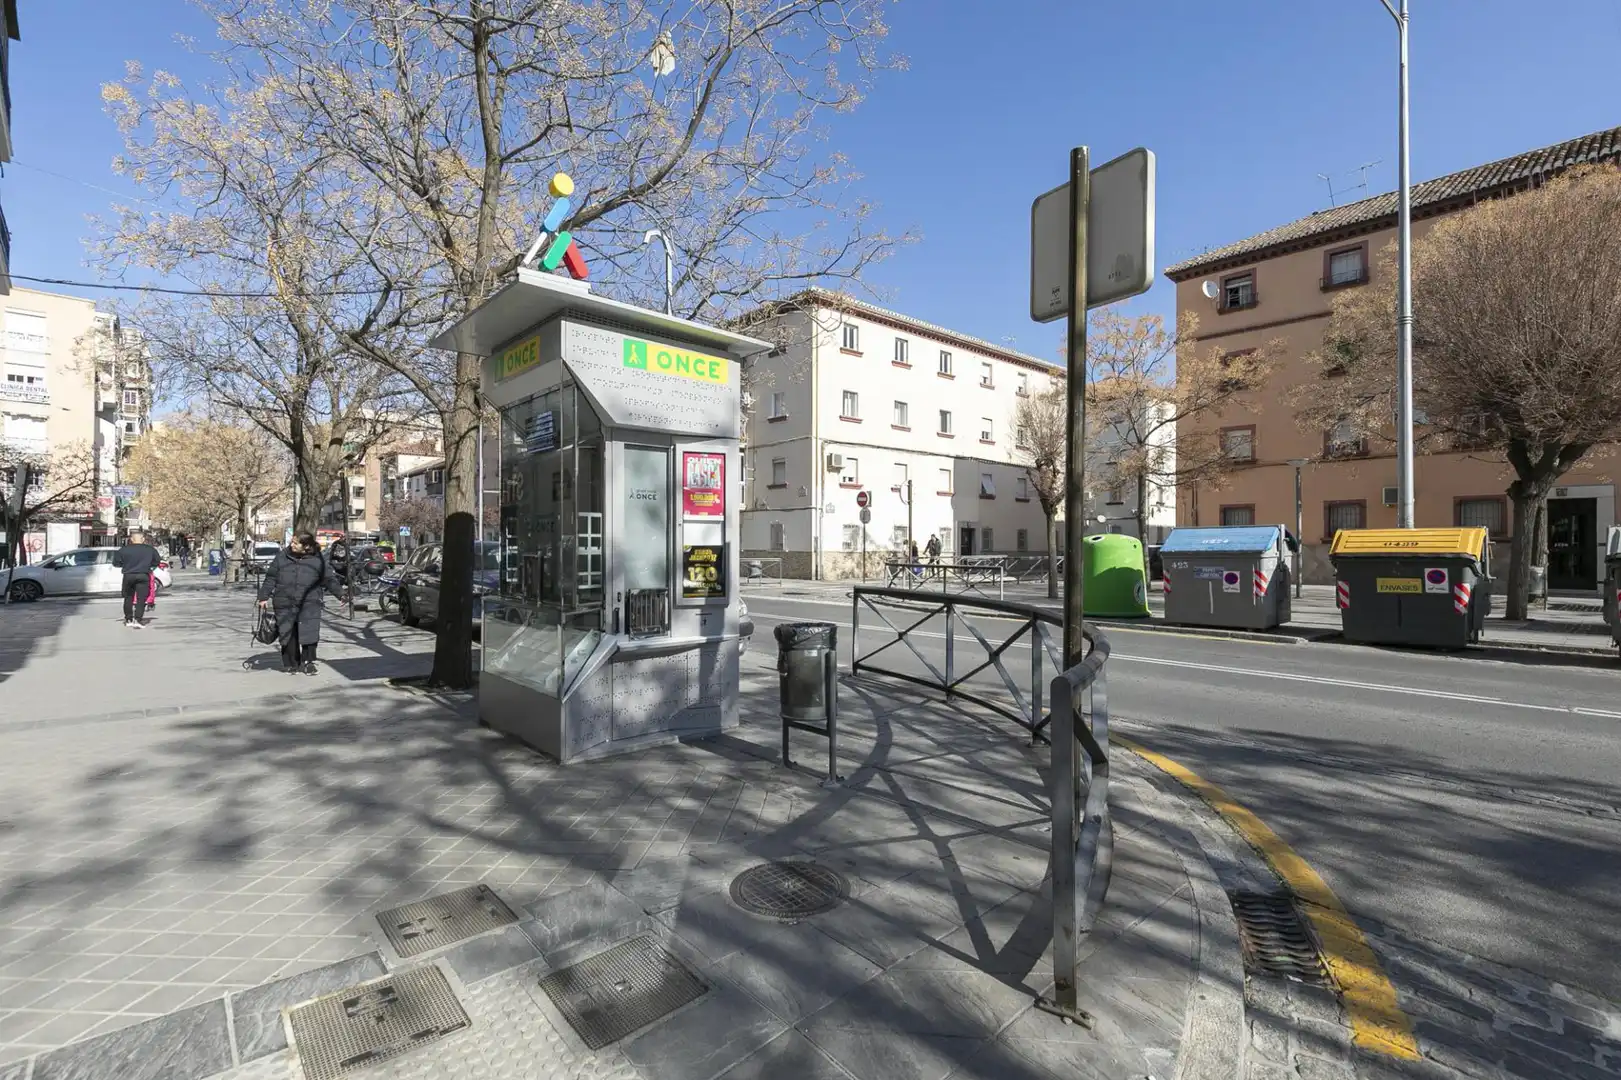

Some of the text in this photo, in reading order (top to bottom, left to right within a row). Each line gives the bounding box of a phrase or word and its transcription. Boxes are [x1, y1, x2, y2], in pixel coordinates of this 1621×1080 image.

[507, 341, 537, 372] ONCE
[656, 351, 720, 379] ONCE
[636, 493, 657, 501] ONCE
[687, 566, 718, 581] 120
